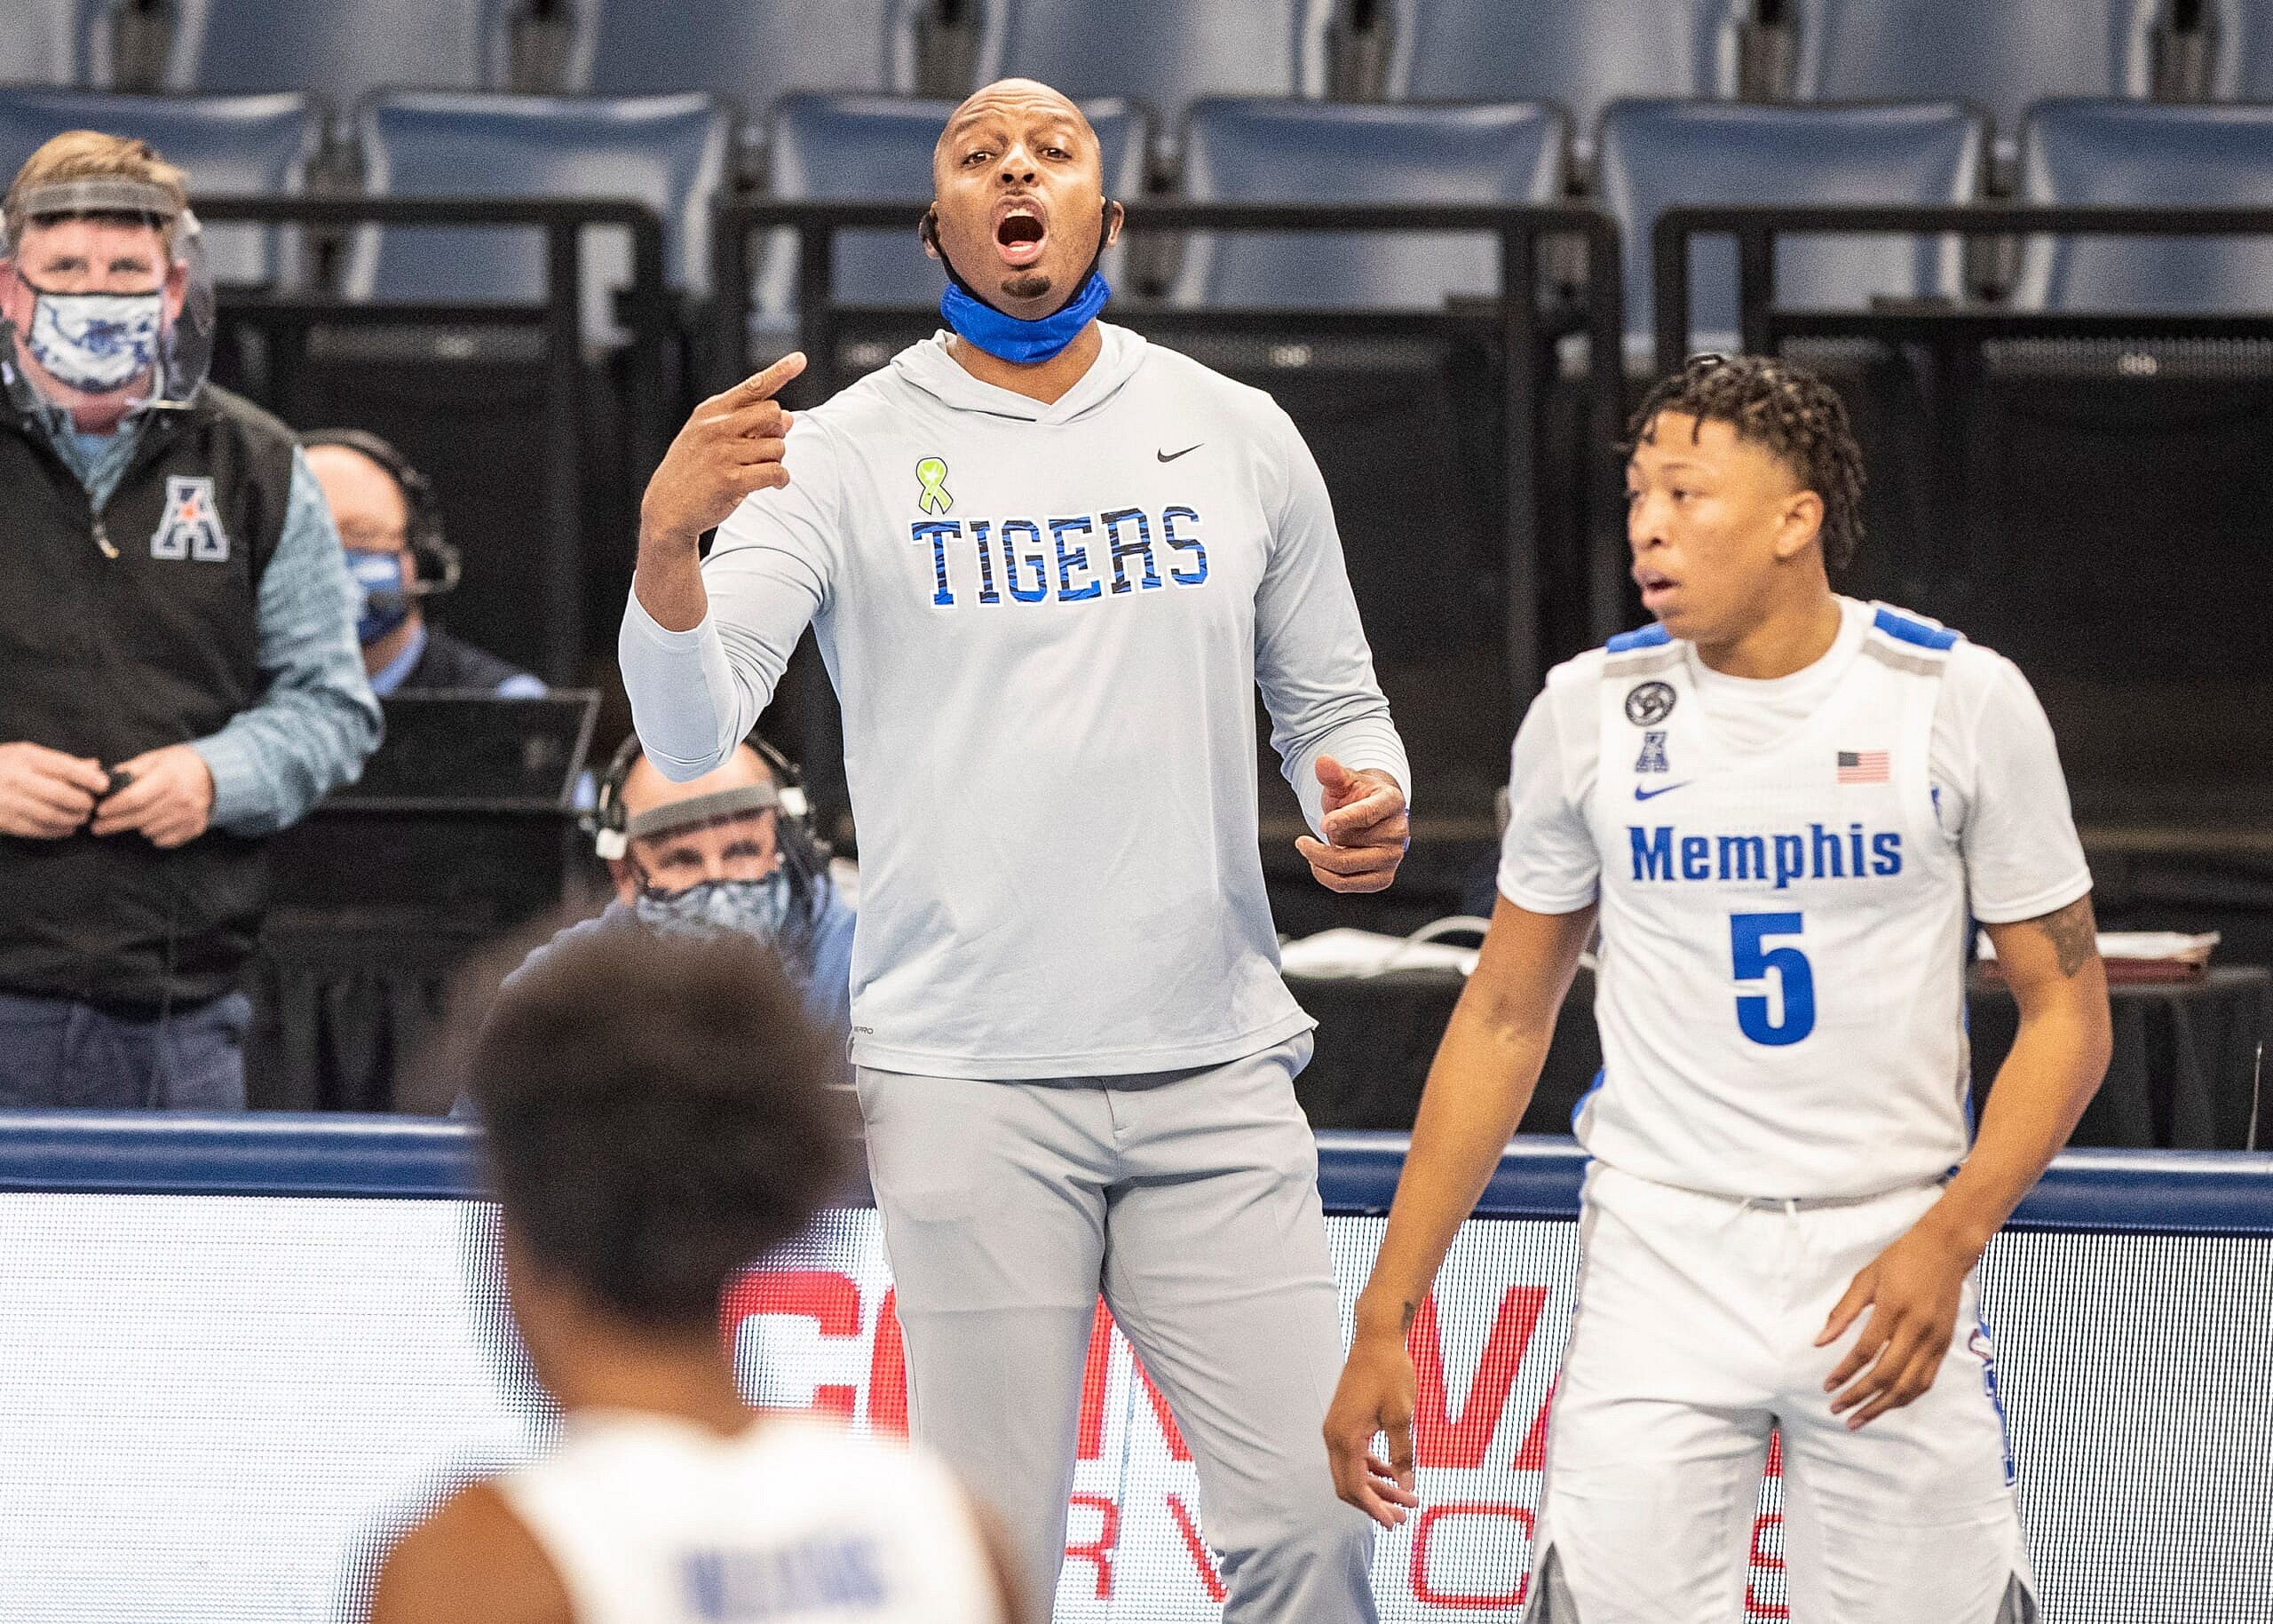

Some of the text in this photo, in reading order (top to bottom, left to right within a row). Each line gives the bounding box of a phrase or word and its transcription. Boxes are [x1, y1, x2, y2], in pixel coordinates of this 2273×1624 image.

[910, 504, 1210, 607] TIGERS
[1627, 822, 1903, 889] Memphis
[1729, 912, 1817, 1047] 5
